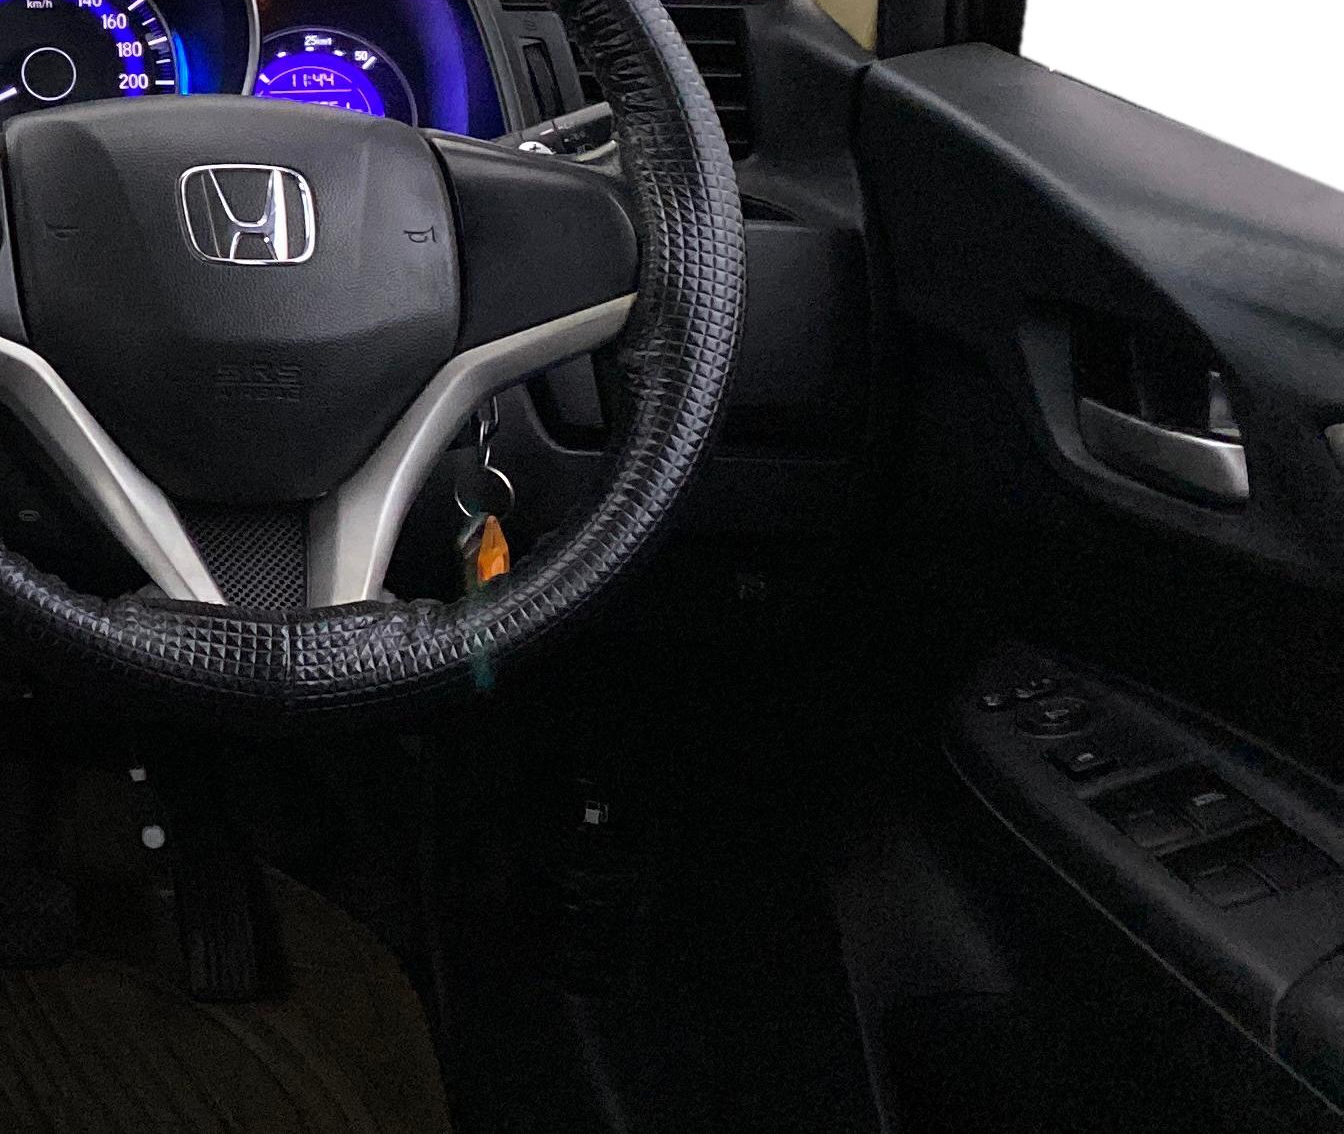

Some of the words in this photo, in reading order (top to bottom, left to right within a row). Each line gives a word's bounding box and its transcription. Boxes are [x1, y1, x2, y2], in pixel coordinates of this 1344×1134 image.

[26, 0, 53, 9] km/h
[101, 14, 127, 29] 160
[116, 41, 142, 57] 180
[355, 50, 367, 61] 50
[118, 74, 149, 89] 200
[292, 73, 334, 88] 11:44
